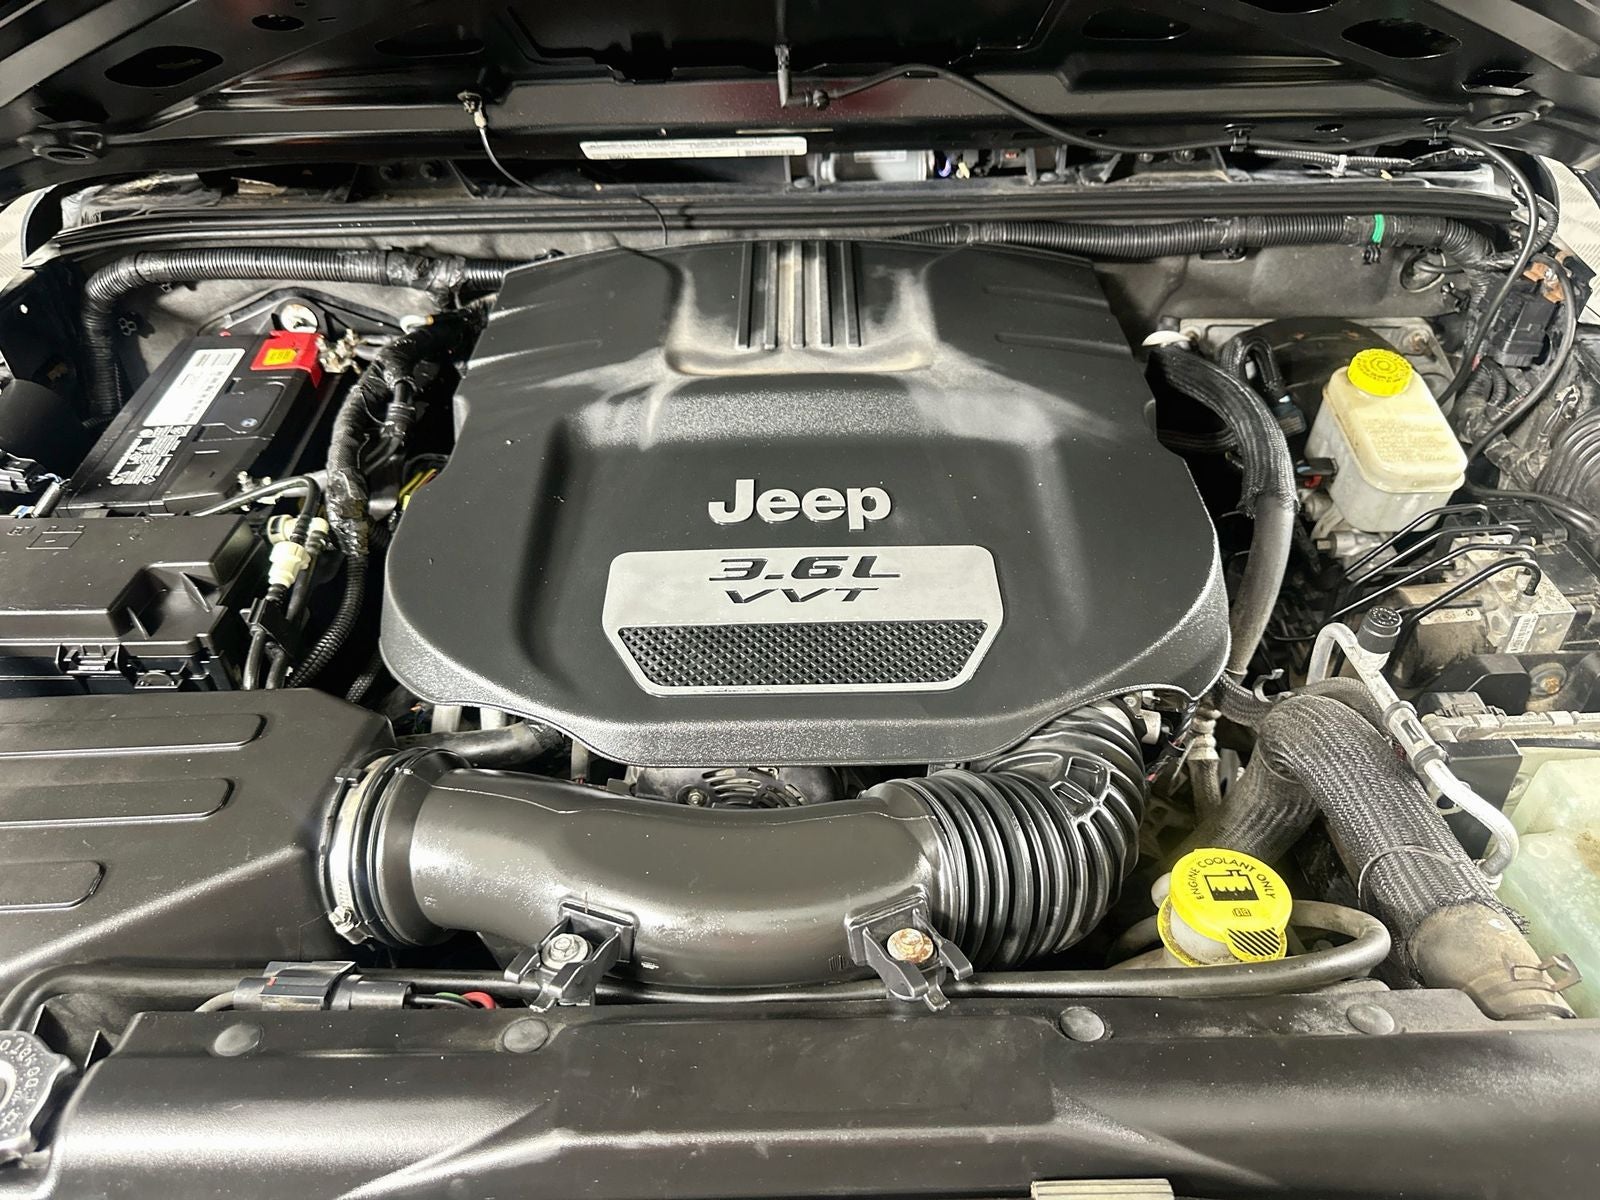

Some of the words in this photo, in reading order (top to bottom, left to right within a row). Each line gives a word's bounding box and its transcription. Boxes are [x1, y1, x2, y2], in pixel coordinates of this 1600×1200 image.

[708, 479, 892, 532] Jeep
[709, 555, 901, 580] 3.6L
[724, 587, 879, 604] VVT
[1187, 867, 1204, 900] ENGINE
[1198, 857, 1256, 872] COOLANT
[1256, 873, 1276, 899] ONLY
